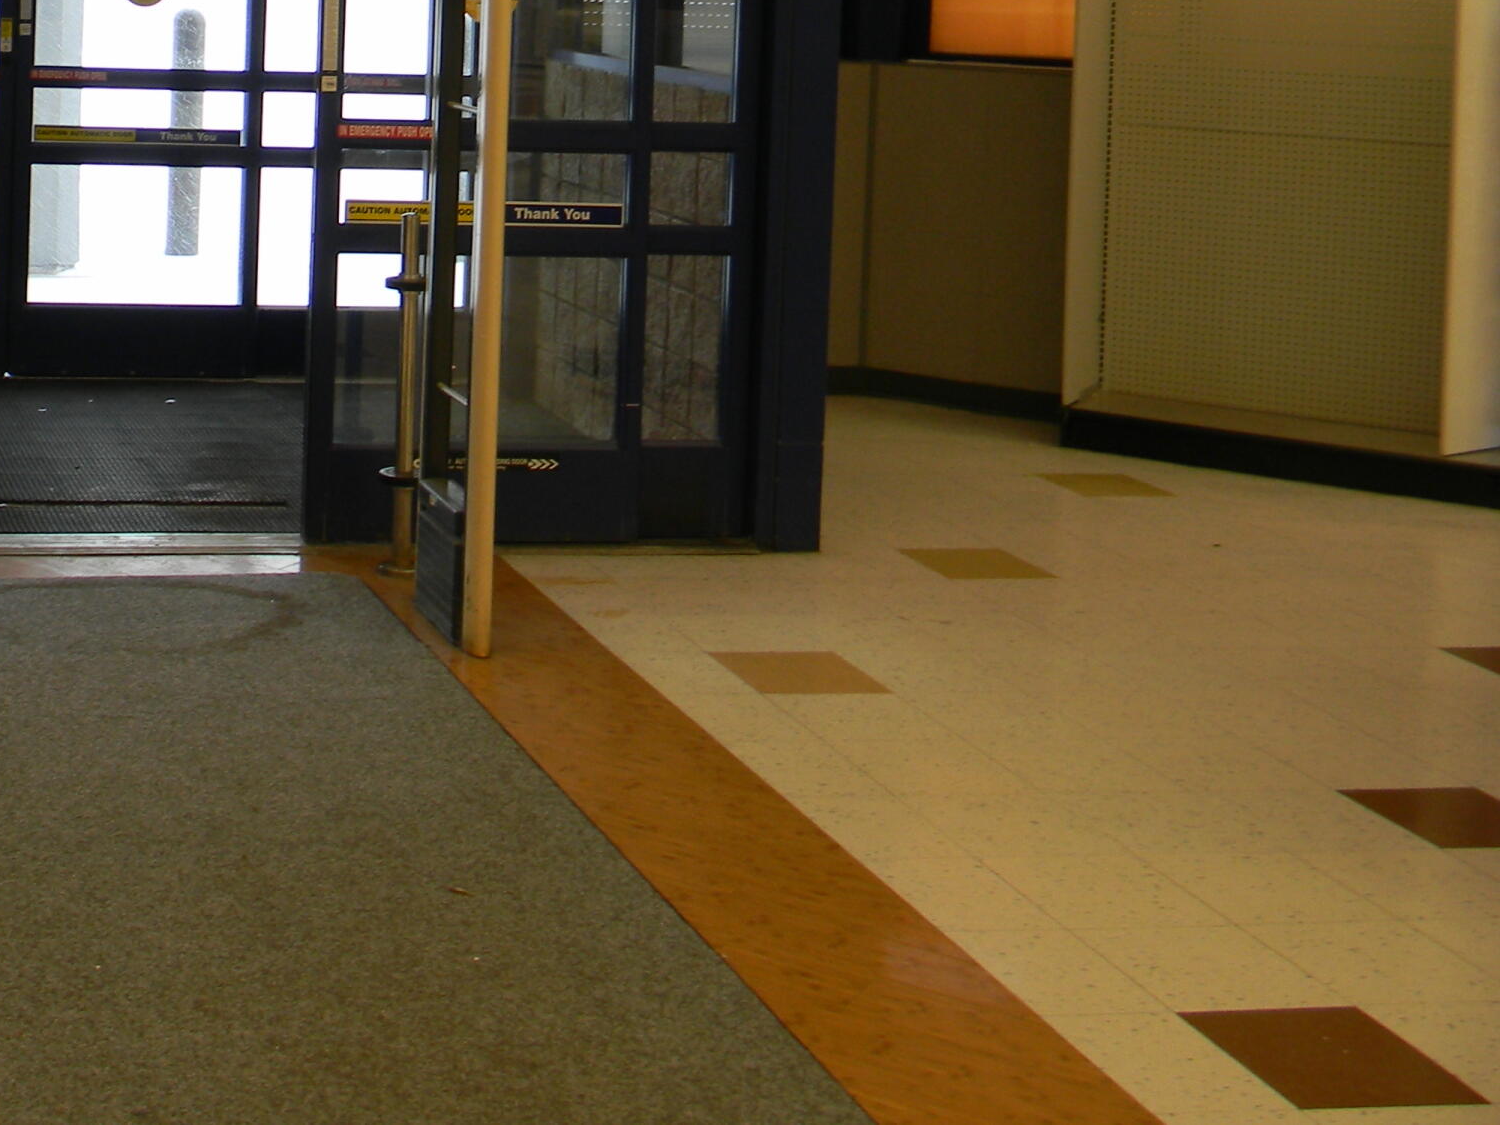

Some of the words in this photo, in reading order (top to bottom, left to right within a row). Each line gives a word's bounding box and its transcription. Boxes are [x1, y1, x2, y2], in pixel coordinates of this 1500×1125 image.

[160, 131, 193, 141] Thank
[197, 132, 218, 142] You
[338, 125, 348, 137] IN
[349, 125, 396, 137] EMERGENCY
[397, 126, 418, 138] PUSH
[348, 205, 391, 215] CAUTION
[513, 206, 560, 220] Thank
[564, 208, 592, 221] You
